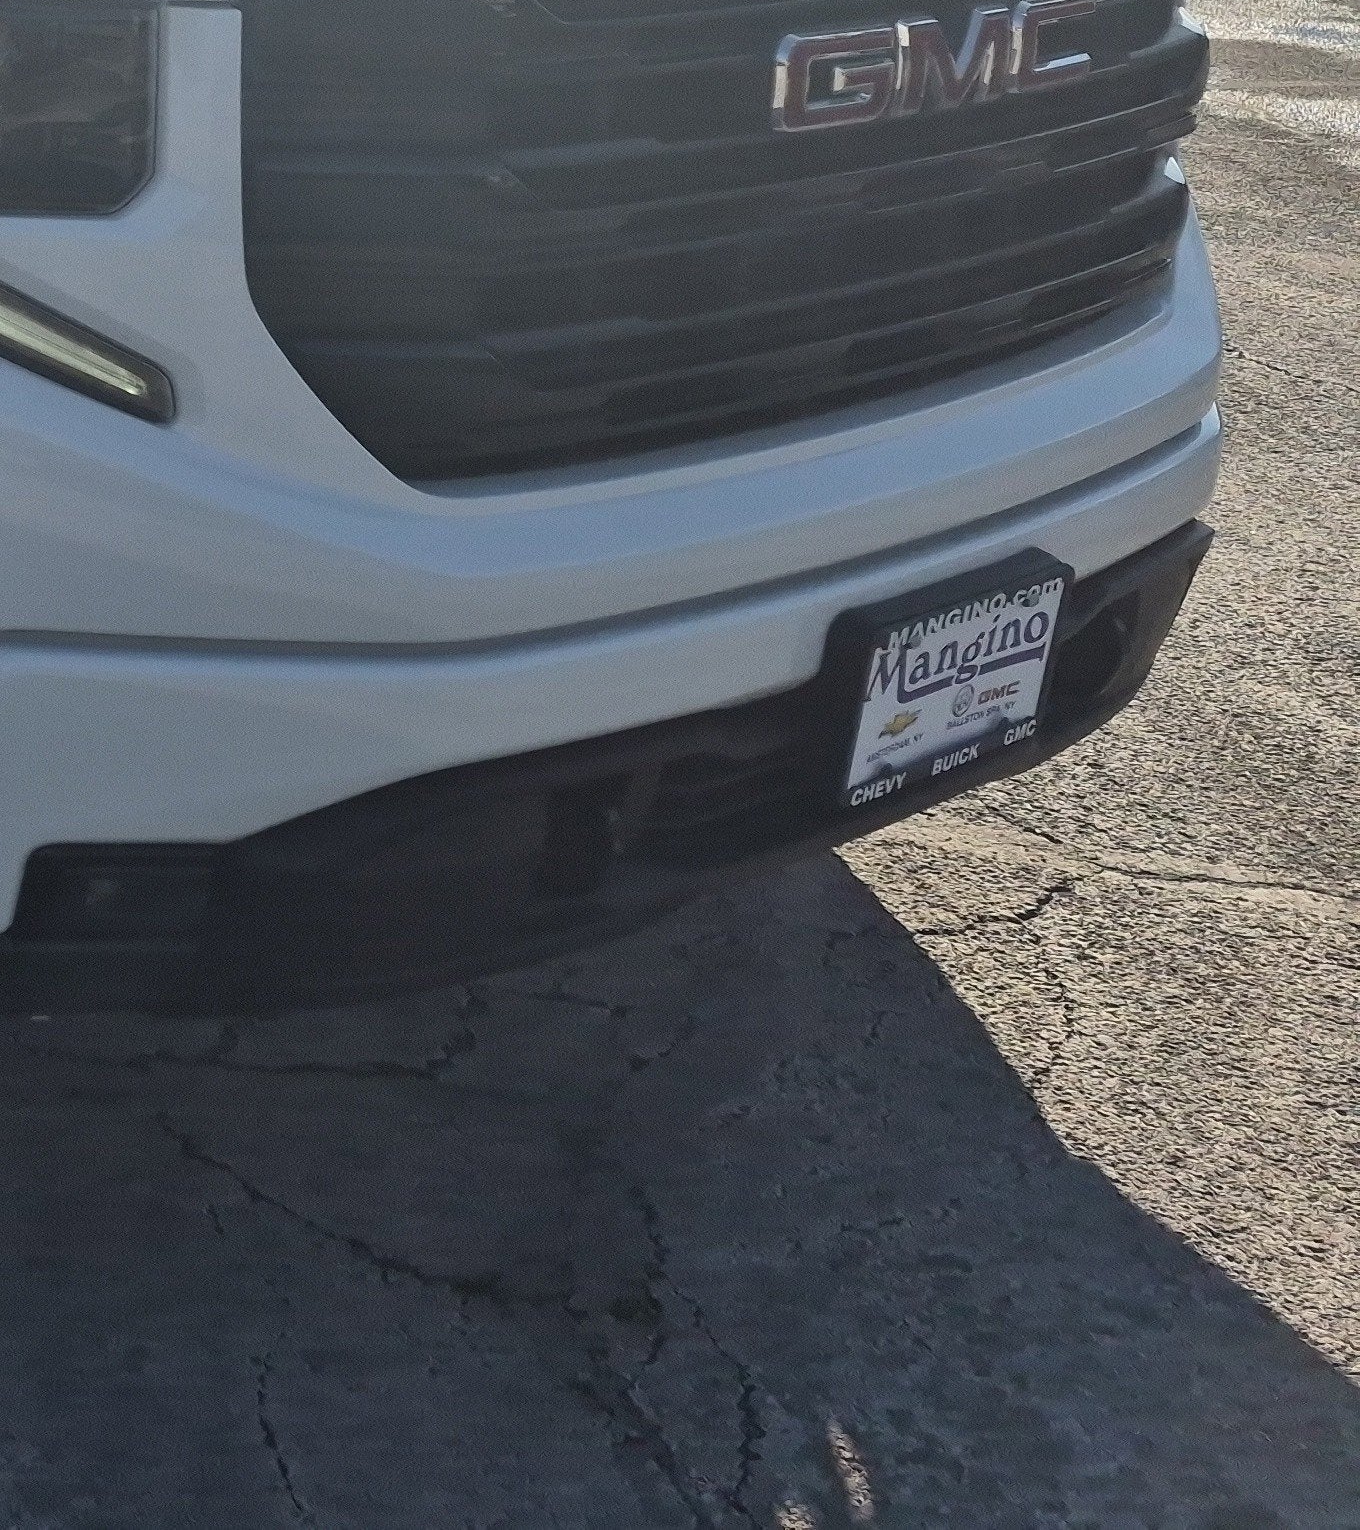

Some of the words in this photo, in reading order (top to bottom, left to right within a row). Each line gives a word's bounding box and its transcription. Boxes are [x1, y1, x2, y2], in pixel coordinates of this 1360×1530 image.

[888, 577, 1064, 651] MANGINO.com
[863, 611, 1050, 703] Mangino
[978, 679, 1021, 705] GMC
[850, 772, 907, 806] CHEVY
[931, 743, 980, 776] BUICK
[1003, 720, 1038, 746] GMC
